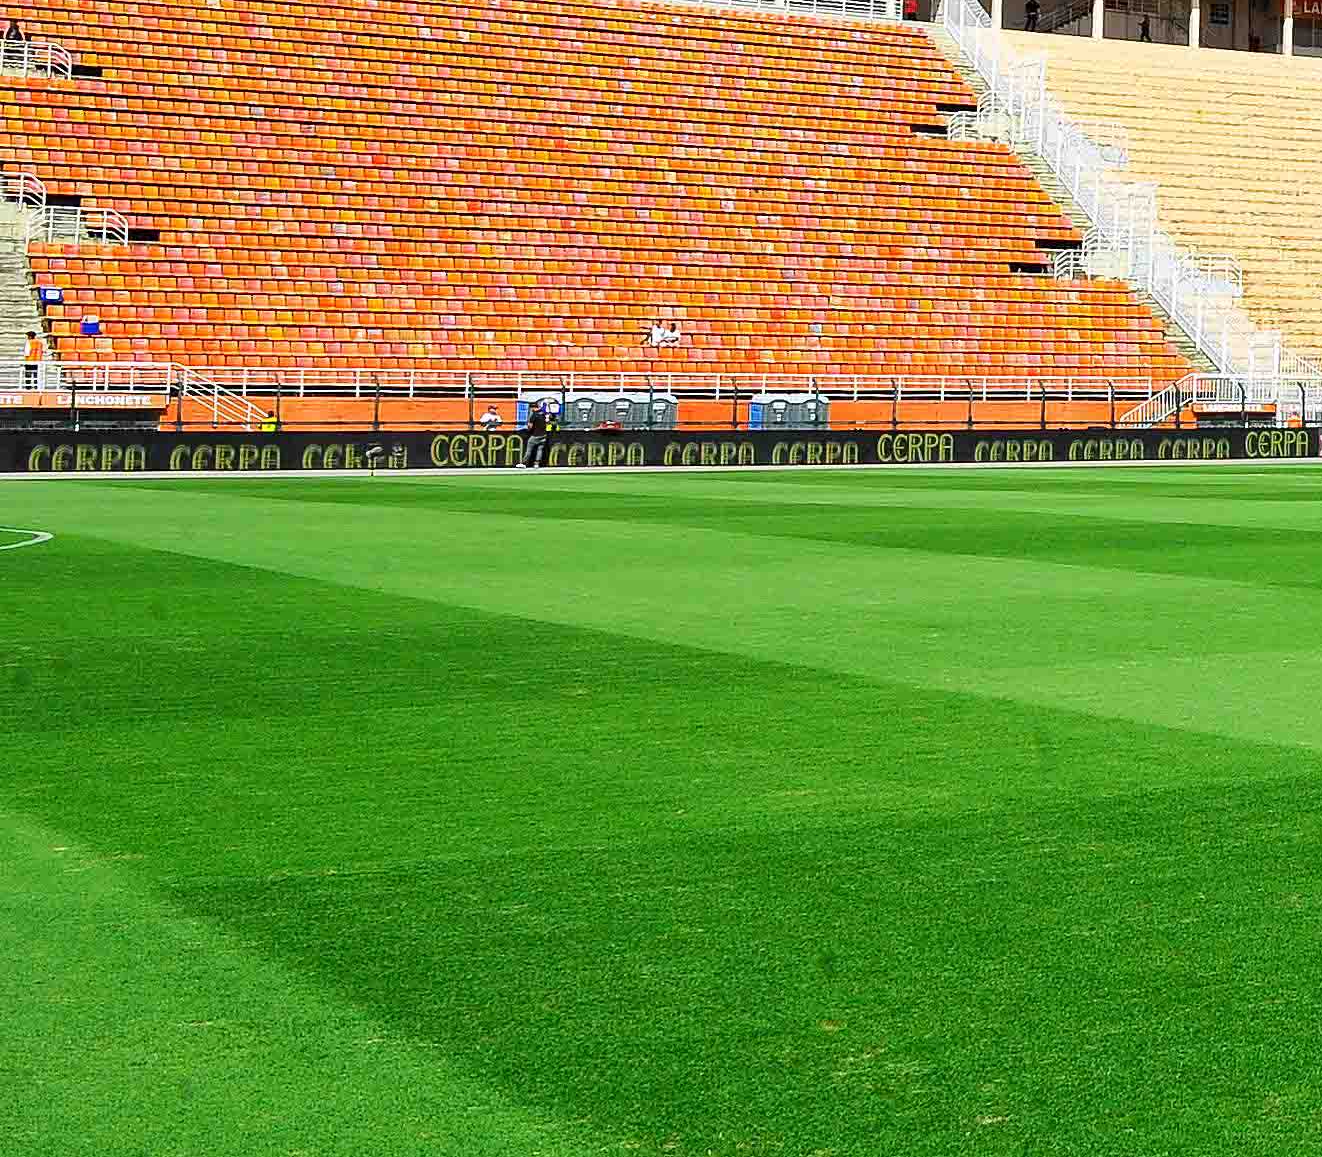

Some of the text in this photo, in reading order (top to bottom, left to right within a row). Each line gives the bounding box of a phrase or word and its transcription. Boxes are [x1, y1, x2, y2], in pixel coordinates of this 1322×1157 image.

[57, 395, 152, 405] LANCHONETE
[430, 434, 525, 467] CERPA
[548, 442, 645, 466] CERPA
[663, 441, 755, 465] CERPA
[772, 441, 859, 464] CERPA
[877, 433, 955, 462] CERPA
[974, 440, 1053, 461] CERPA
[1069, 438, 1144, 460] CERPA
[1157, 437, 1230, 459] CERPA
[1245, 430, 1309, 458] CERPA
[28, 444, 146, 471] CERPA
[169, 443, 281, 470] CERPA
